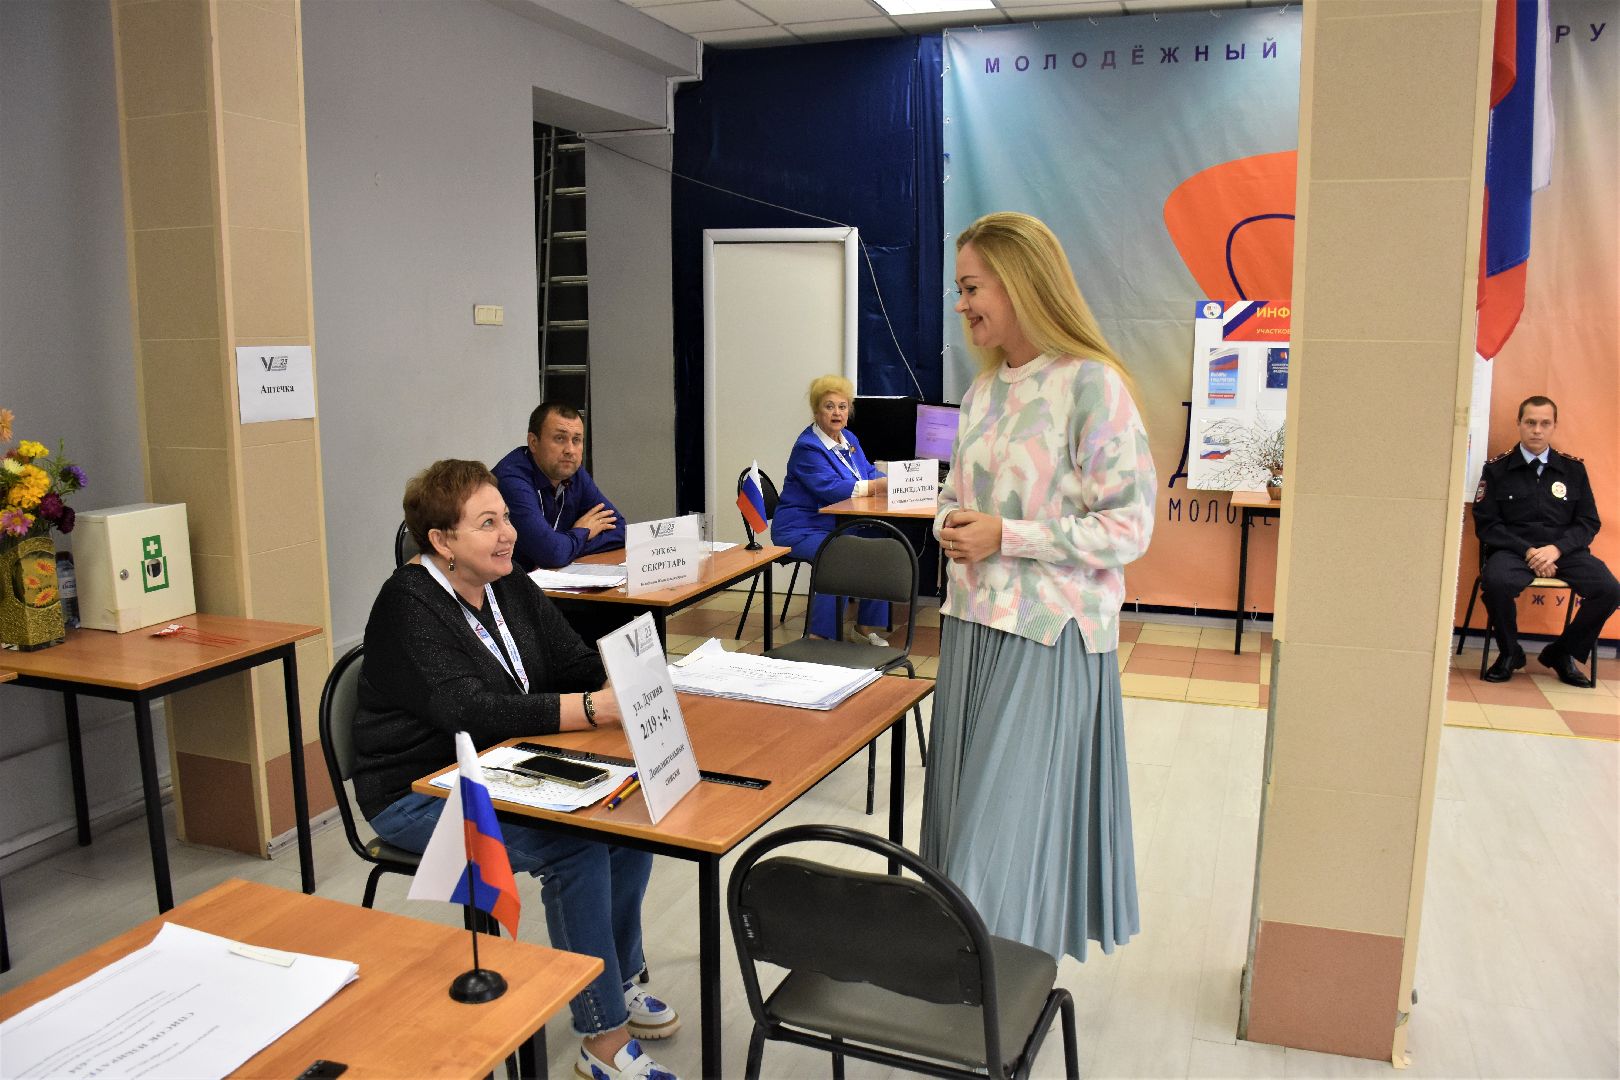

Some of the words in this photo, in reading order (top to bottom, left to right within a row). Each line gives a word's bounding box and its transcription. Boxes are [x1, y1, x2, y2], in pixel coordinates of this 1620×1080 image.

[985, 37, 1277, 74] МОЛОДЁЖНЫЙ
[1256, 306, 1290, 319] ИНФ
[261, 384, 295, 395] Аптечка
[641, 558, 686, 573] СЕКРЕТАРЬ
[633, 701, 644, 717] ул.
[642, 685, 664, 710] Дугина
